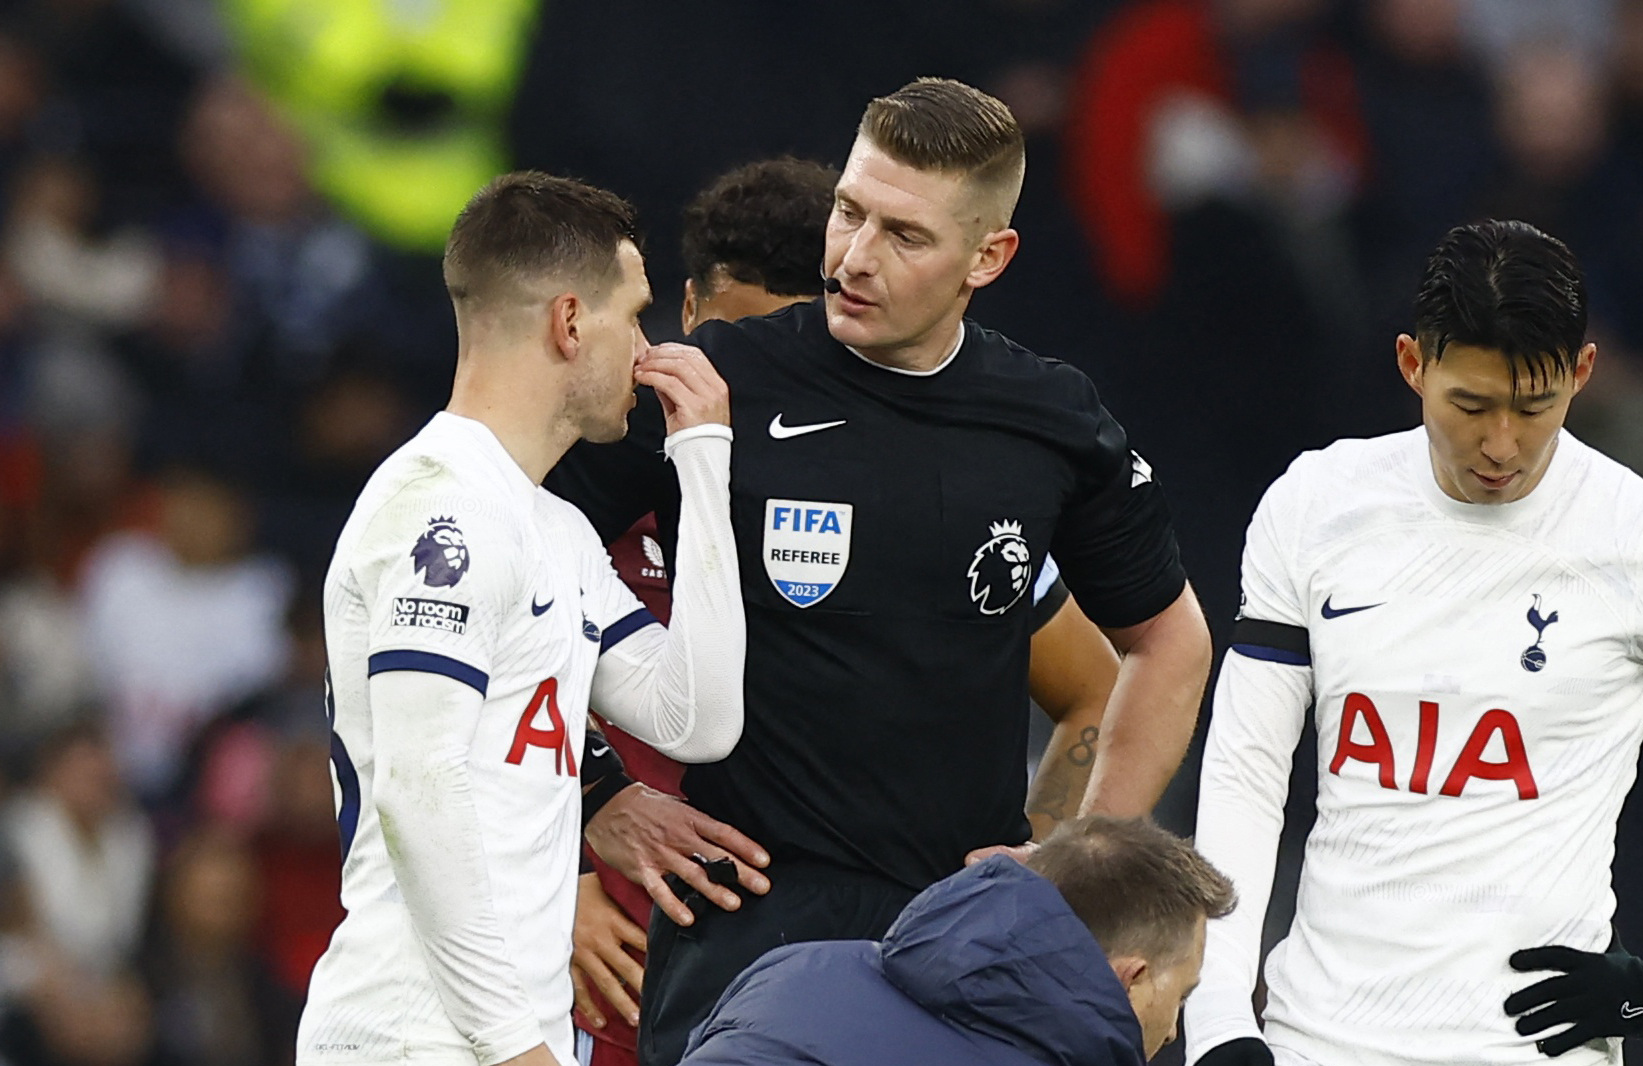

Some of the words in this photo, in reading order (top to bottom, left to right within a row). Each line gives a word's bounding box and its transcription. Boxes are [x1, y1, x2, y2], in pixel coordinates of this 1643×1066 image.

[773, 507, 842, 534] FIFA
[771, 549, 841, 565] REFEREE
[787, 584, 820, 597] 2023
[394, 599, 416, 613] No
[418, 602, 462, 620] room
[392, 611, 415, 626] for
[416, 615, 466, 634] racism
[1329, 692, 1539, 800] AIA
